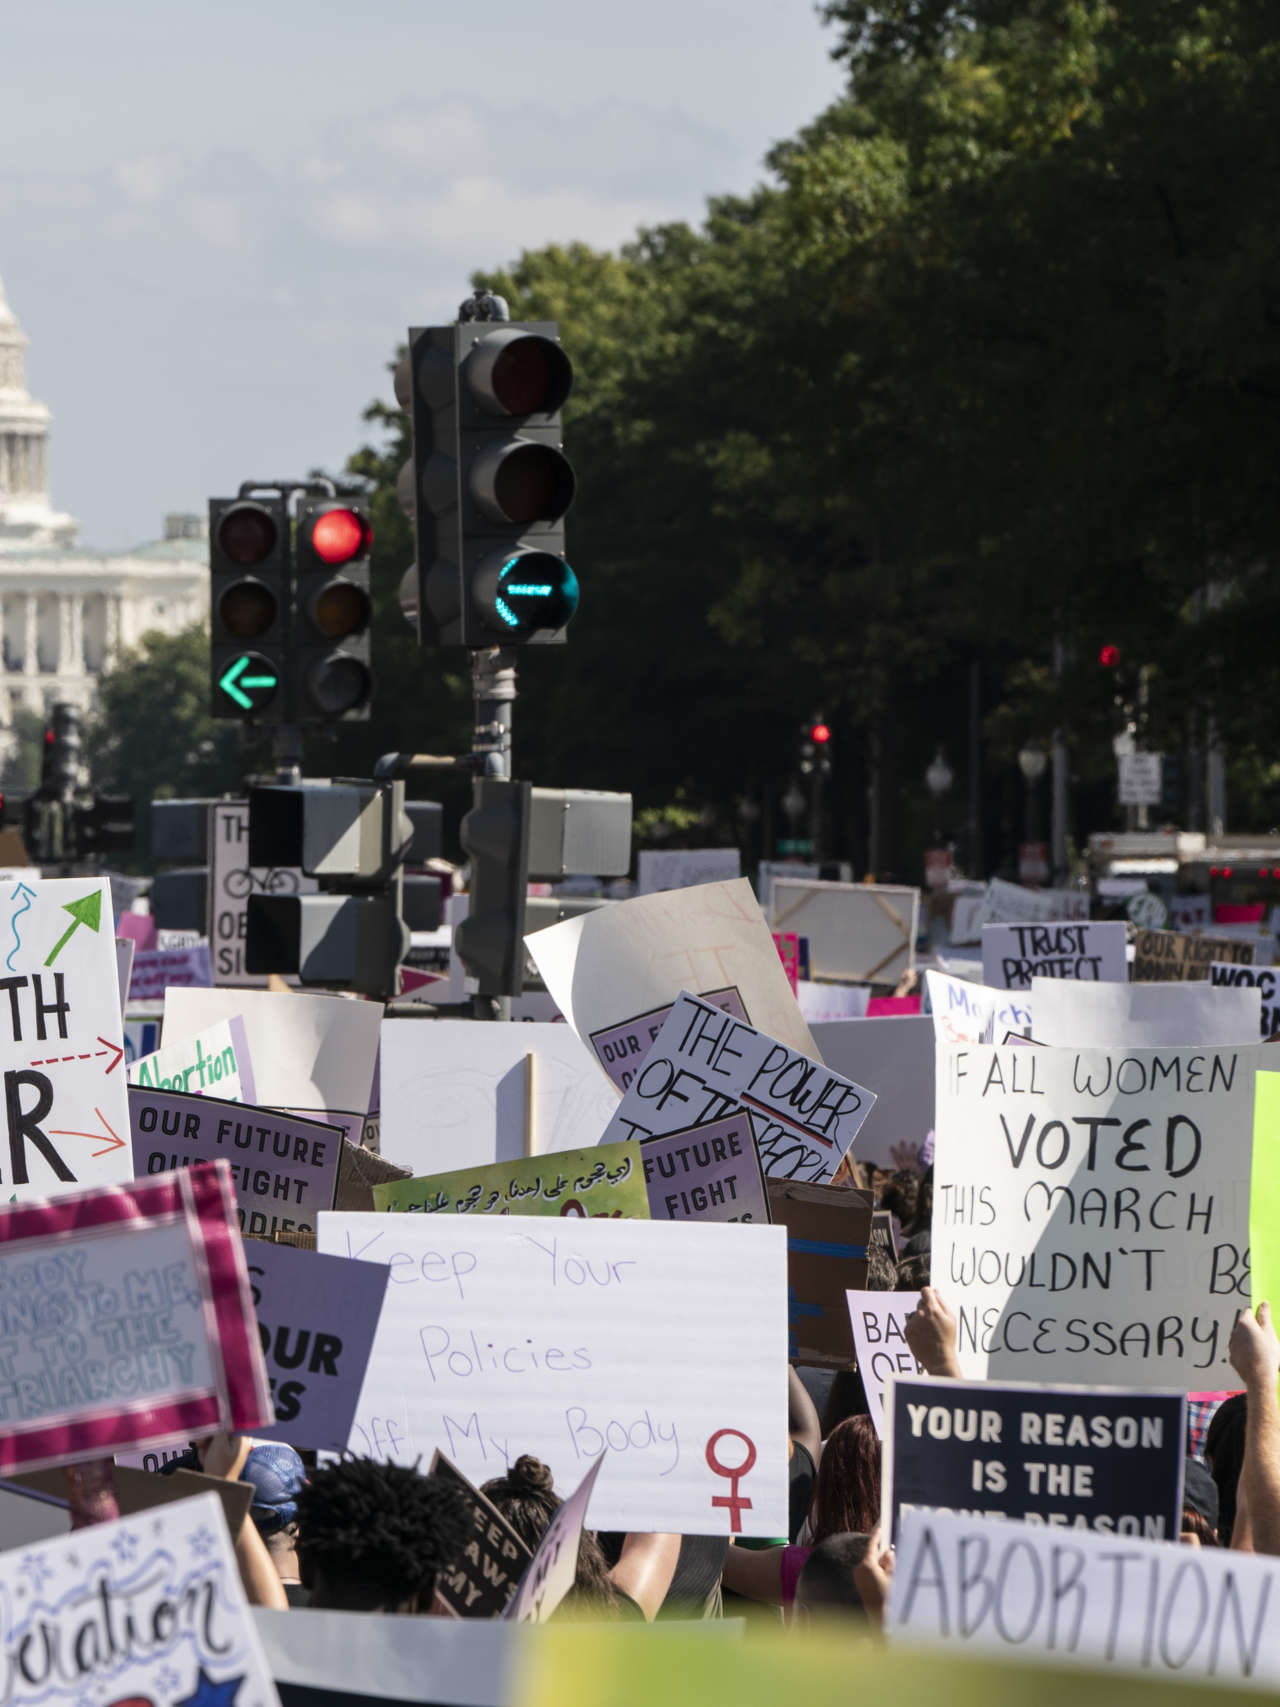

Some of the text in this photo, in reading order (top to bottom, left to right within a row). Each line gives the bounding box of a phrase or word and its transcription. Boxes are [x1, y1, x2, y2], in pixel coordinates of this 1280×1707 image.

[1010, 926, 1089, 957] TRUST
[1002, 957, 1103, 989] PROTECT
[138, 1039, 238, 1094] Abortion
[603, 1034, 642, 1063] OUR
[679, 998, 758, 1076] THE
[747, 1044, 862, 1135] POWER
[949, 1052, 1238, 1098] IF ALL WOMEN
[637, 1058, 707, 1111] OF
[139, 1106, 201, 1140] OUR
[217, 1119, 327, 1168] FUTURE
[643, 1131, 743, 1184] FUTURE
[999, 1112, 1202, 1179] VOTED
[665, 1175, 738, 1221] FIGHT
[940, 1180, 1215, 1234] THIS MARCH
[515, 1233, 637, 1287] Your
[950, 1241, 1166, 1292] WOULDN'T
[80, 1284, 118, 1316] TO
[33, 1331, 86, 1372] TO
[93, 1310, 185, 1352] THE
[419, 1325, 593, 1383] Policies
[862, 1311, 908, 1344] BA
[871, 1352, 924, 1384] OF
[442, 1411, 510, 1466] My
[565, 1406, 680, 1477] Body
[906, 1403, 1164, 1450] YOUR REASON
[972, 1458, 1095, 1498] IS THE
[898, 1525, 1273, 1677] ABORTION
